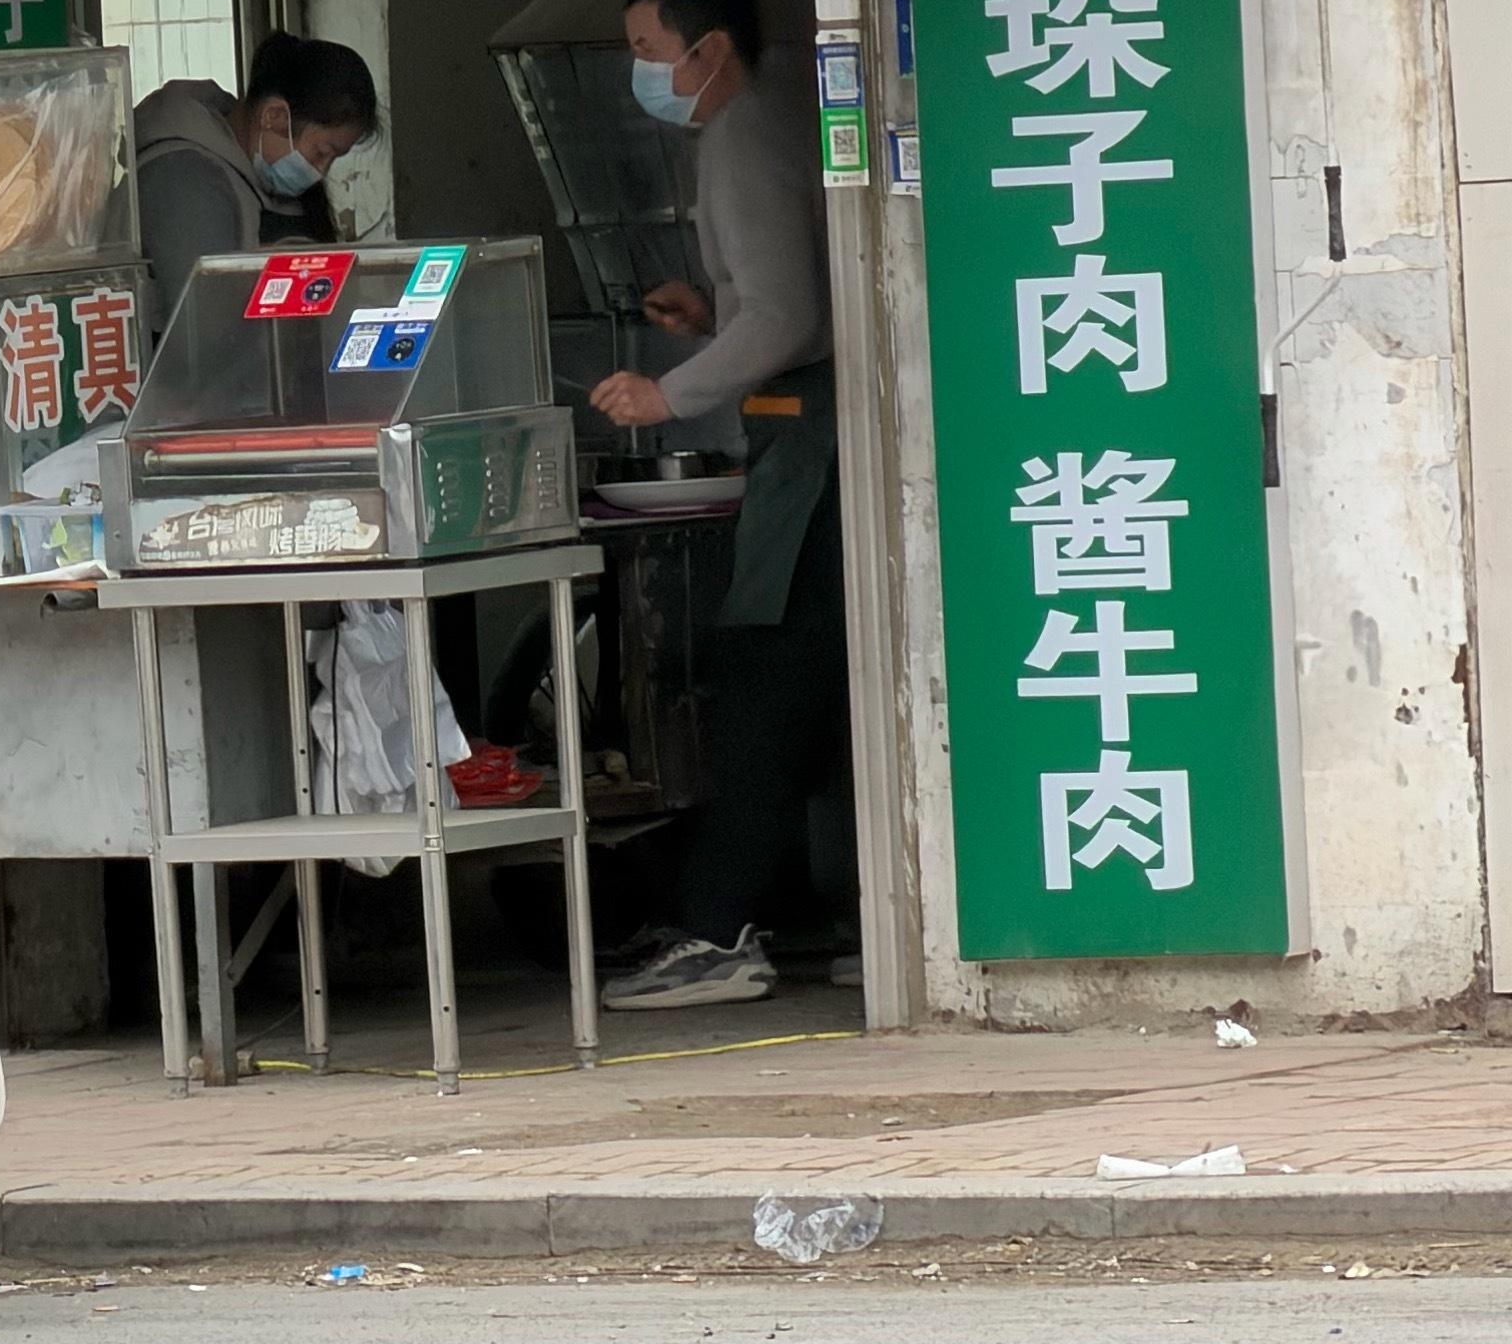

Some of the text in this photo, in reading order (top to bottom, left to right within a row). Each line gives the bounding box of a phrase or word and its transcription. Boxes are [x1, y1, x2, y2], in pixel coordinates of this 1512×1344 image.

[0, 288, 140, 431] 清真
[1009, 450, 1198, 892] 酱牛肉
